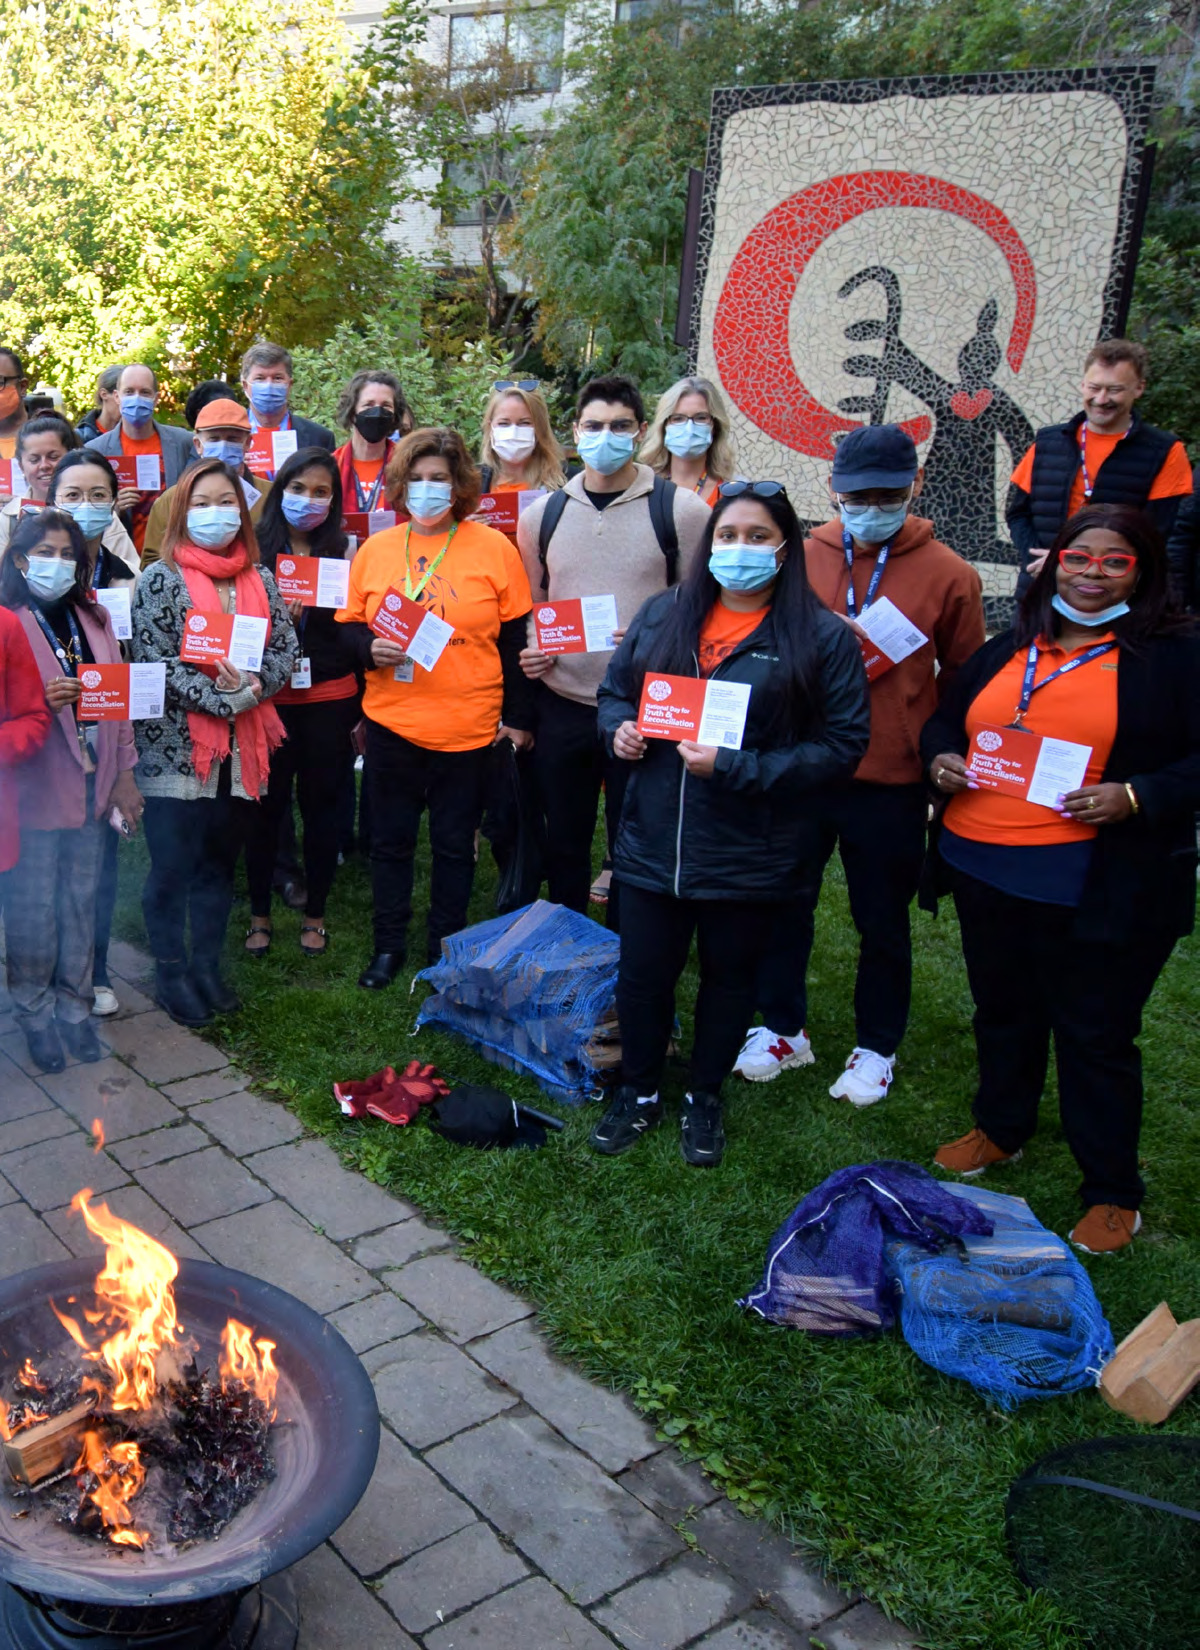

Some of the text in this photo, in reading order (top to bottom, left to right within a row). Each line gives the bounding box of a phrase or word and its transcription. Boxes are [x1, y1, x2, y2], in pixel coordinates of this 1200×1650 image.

[380, 608, 396, 620] National
[378, 613, 397, 628] Truth &
[376, 615, 409, 640] Reconciliation
[542, 636, 582, 644] Reconciliation
[186, 644, 225, 654] Reconciliation
[644, 708, 672, 718] Truth &
[645, 703, 669, 712] National
[669, 706, 680, 714] Day
[643, 714, 694, 728] Reconciliation
[972, 758, 993, 768] Truth
[973, 752, 998, 762] National
[999, 758, 1011, 766] Day
[970, 763, 1026, 783] Reconciliation
